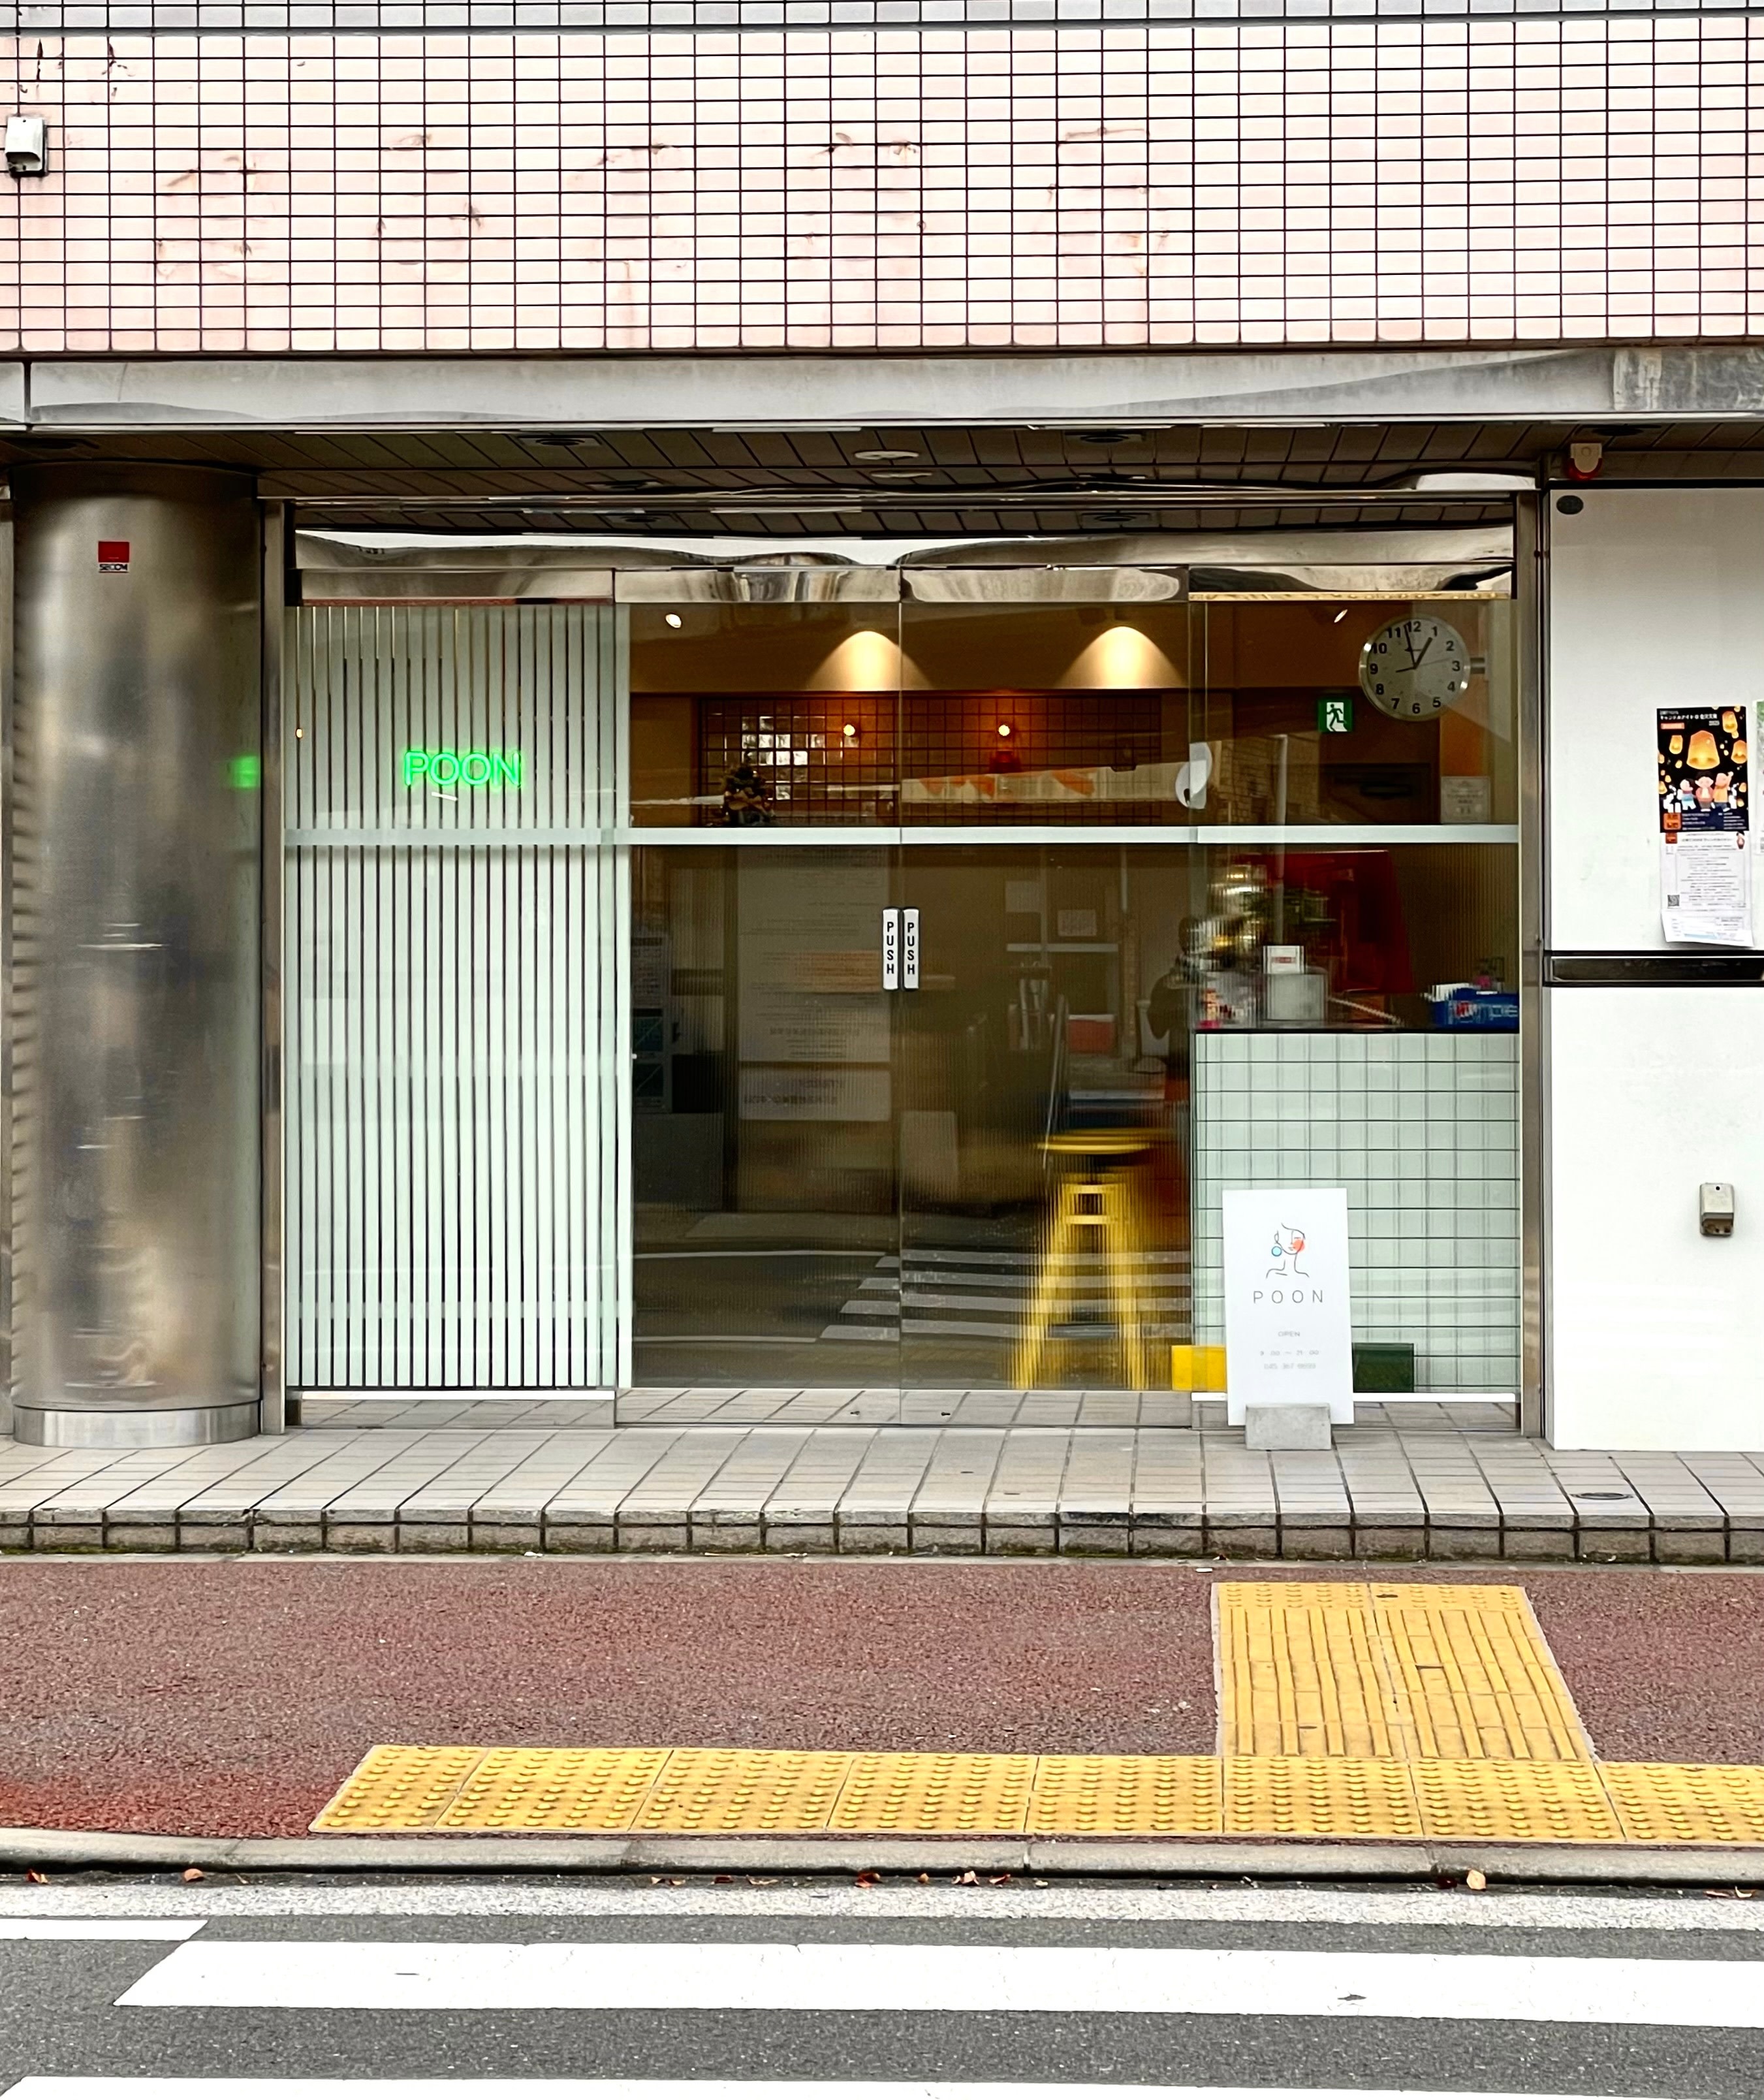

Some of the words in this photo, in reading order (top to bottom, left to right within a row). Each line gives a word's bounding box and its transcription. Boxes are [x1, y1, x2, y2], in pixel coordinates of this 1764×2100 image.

[1406, 621, 1421, 632] 12
[1432, 626, 1438, 637] 1
[1387, 627, 1401, 638] 11
[1371, 643, 1387, 654] 10
[1446, 641, 1454, 651] 2
[1370, 663, 1378, 675] 9
[1452, 661, 1460, 671] 3
[1376, 684, 1384, 695] 8
[1447, 681, 1455, 692] 4
[1391, 698, 1400, 709] 7
[1432, 697, 1441, 708] 5
[1412, 703, 1421, 714] 6
[405, 751, 521, 787] POON
[1253, 1290, 1323, 1304] POON
